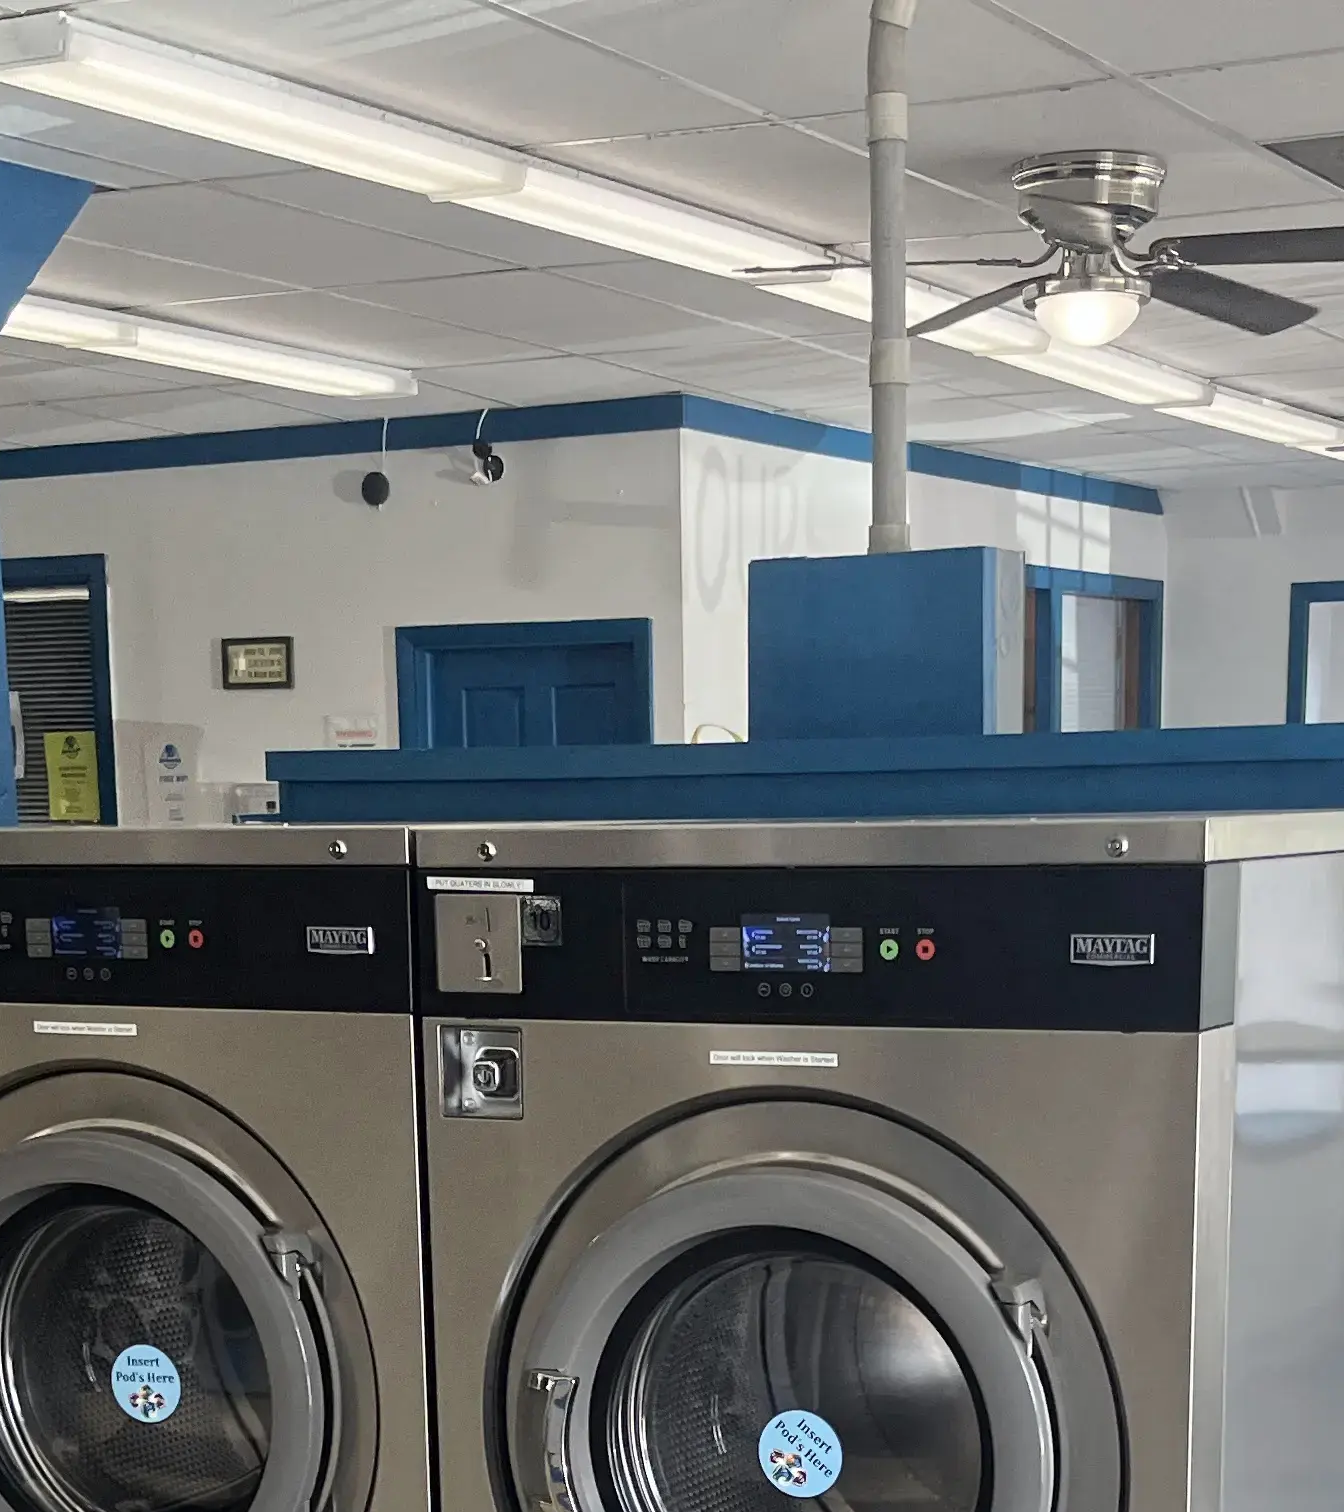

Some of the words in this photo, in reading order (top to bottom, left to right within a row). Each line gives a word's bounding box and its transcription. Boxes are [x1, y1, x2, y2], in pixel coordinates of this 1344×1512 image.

[311, 930, 367, 945] MAYTAG
[879, 927, 900, 935] START
[1076, 938, 1148, 954] MAYTAG
[127, 1355, 160, 1368] Insert
[116, 1371, 145, 1383] Pod's
[147, 1372, 175, 1384] Here
[796, 1418, 833, 1455] Insert
[775, 1420, 805, 1452] Pod's
[804, 1448, 834, 1478] Here
